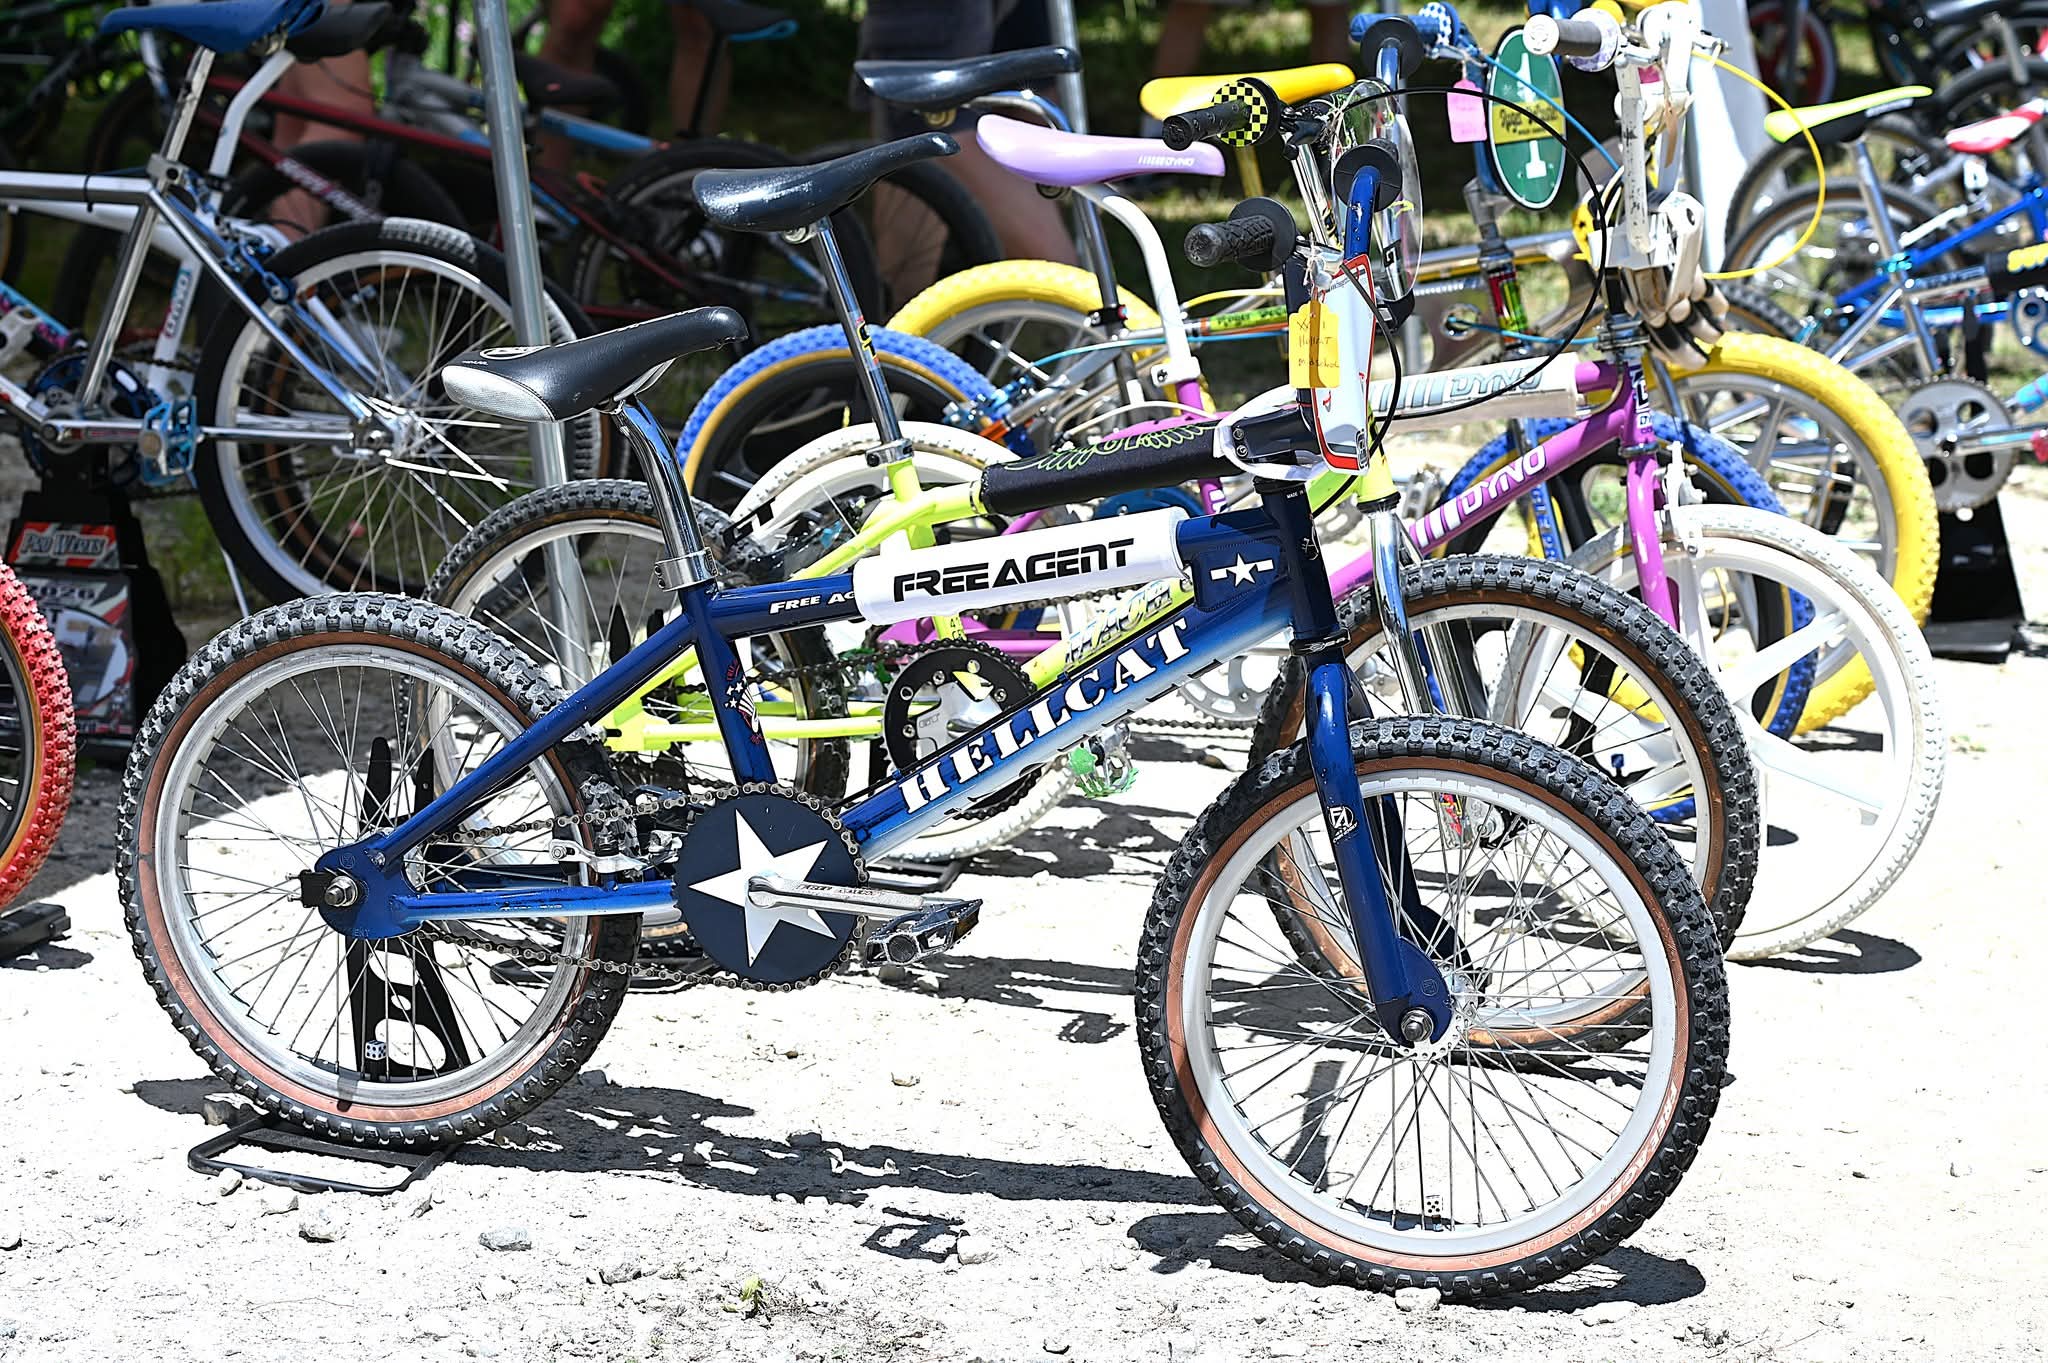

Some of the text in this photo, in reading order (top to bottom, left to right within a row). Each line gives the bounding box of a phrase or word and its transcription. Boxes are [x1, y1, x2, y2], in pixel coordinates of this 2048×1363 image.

[1450, 367, 1543, 398] DYNO
[1461, 445, 1546, 516] DYNO
[769, 595, 821, 614] FREE
[898, 617, 1190, 814] HELLCAT
